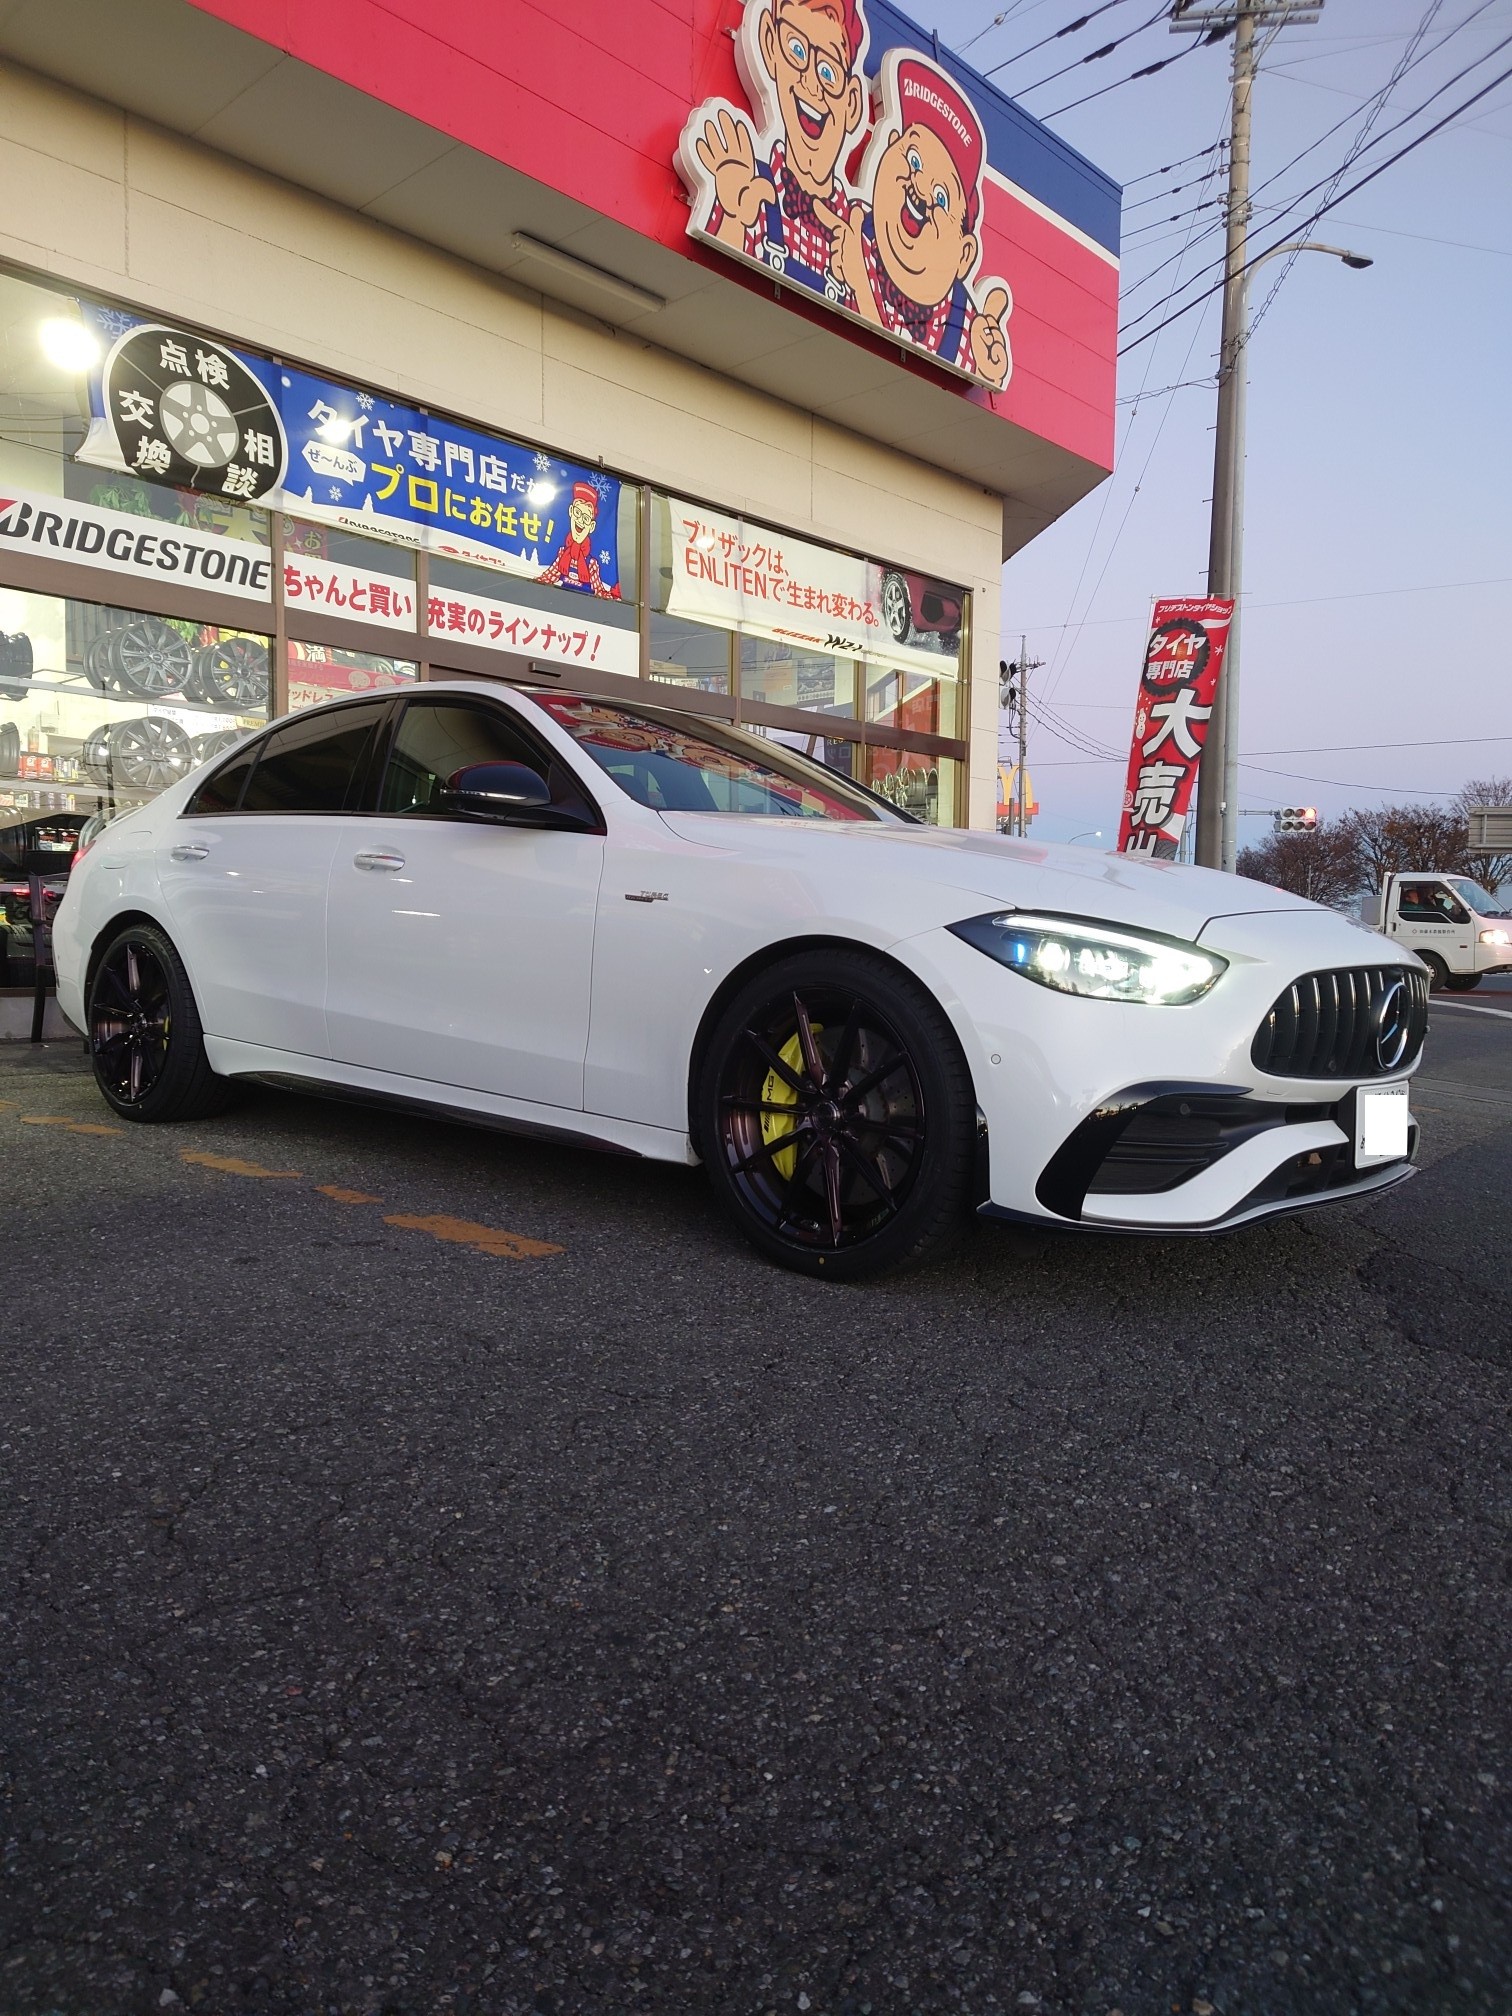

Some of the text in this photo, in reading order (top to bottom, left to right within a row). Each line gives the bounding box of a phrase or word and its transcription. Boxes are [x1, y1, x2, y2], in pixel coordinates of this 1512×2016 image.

[904, 78, 972, 147] BRIDGESTONE
[159, 339, 230, 390] 点検
[118, 390, 173, 475] 交換
[221, 429, 275, 501] 相談
[307, 399, 550, 495] タイヤ専門店だか
[371, 461, 555, 544] プロにお任せ！
[0, 500, 271, 590] BRIDGESTONE
[683, 519, 790, 577] ブリザックは、
[283, 564, 412, 618] ちゃんと買い
[685, 547, 880, 629] ENLITENで生まれ変わる。
[428, 596, 601, 662] 充実のラインナップ！
[1149, 633, 1207, 657] タイヤ
[1146, 660, 1194, 680] 専門店
